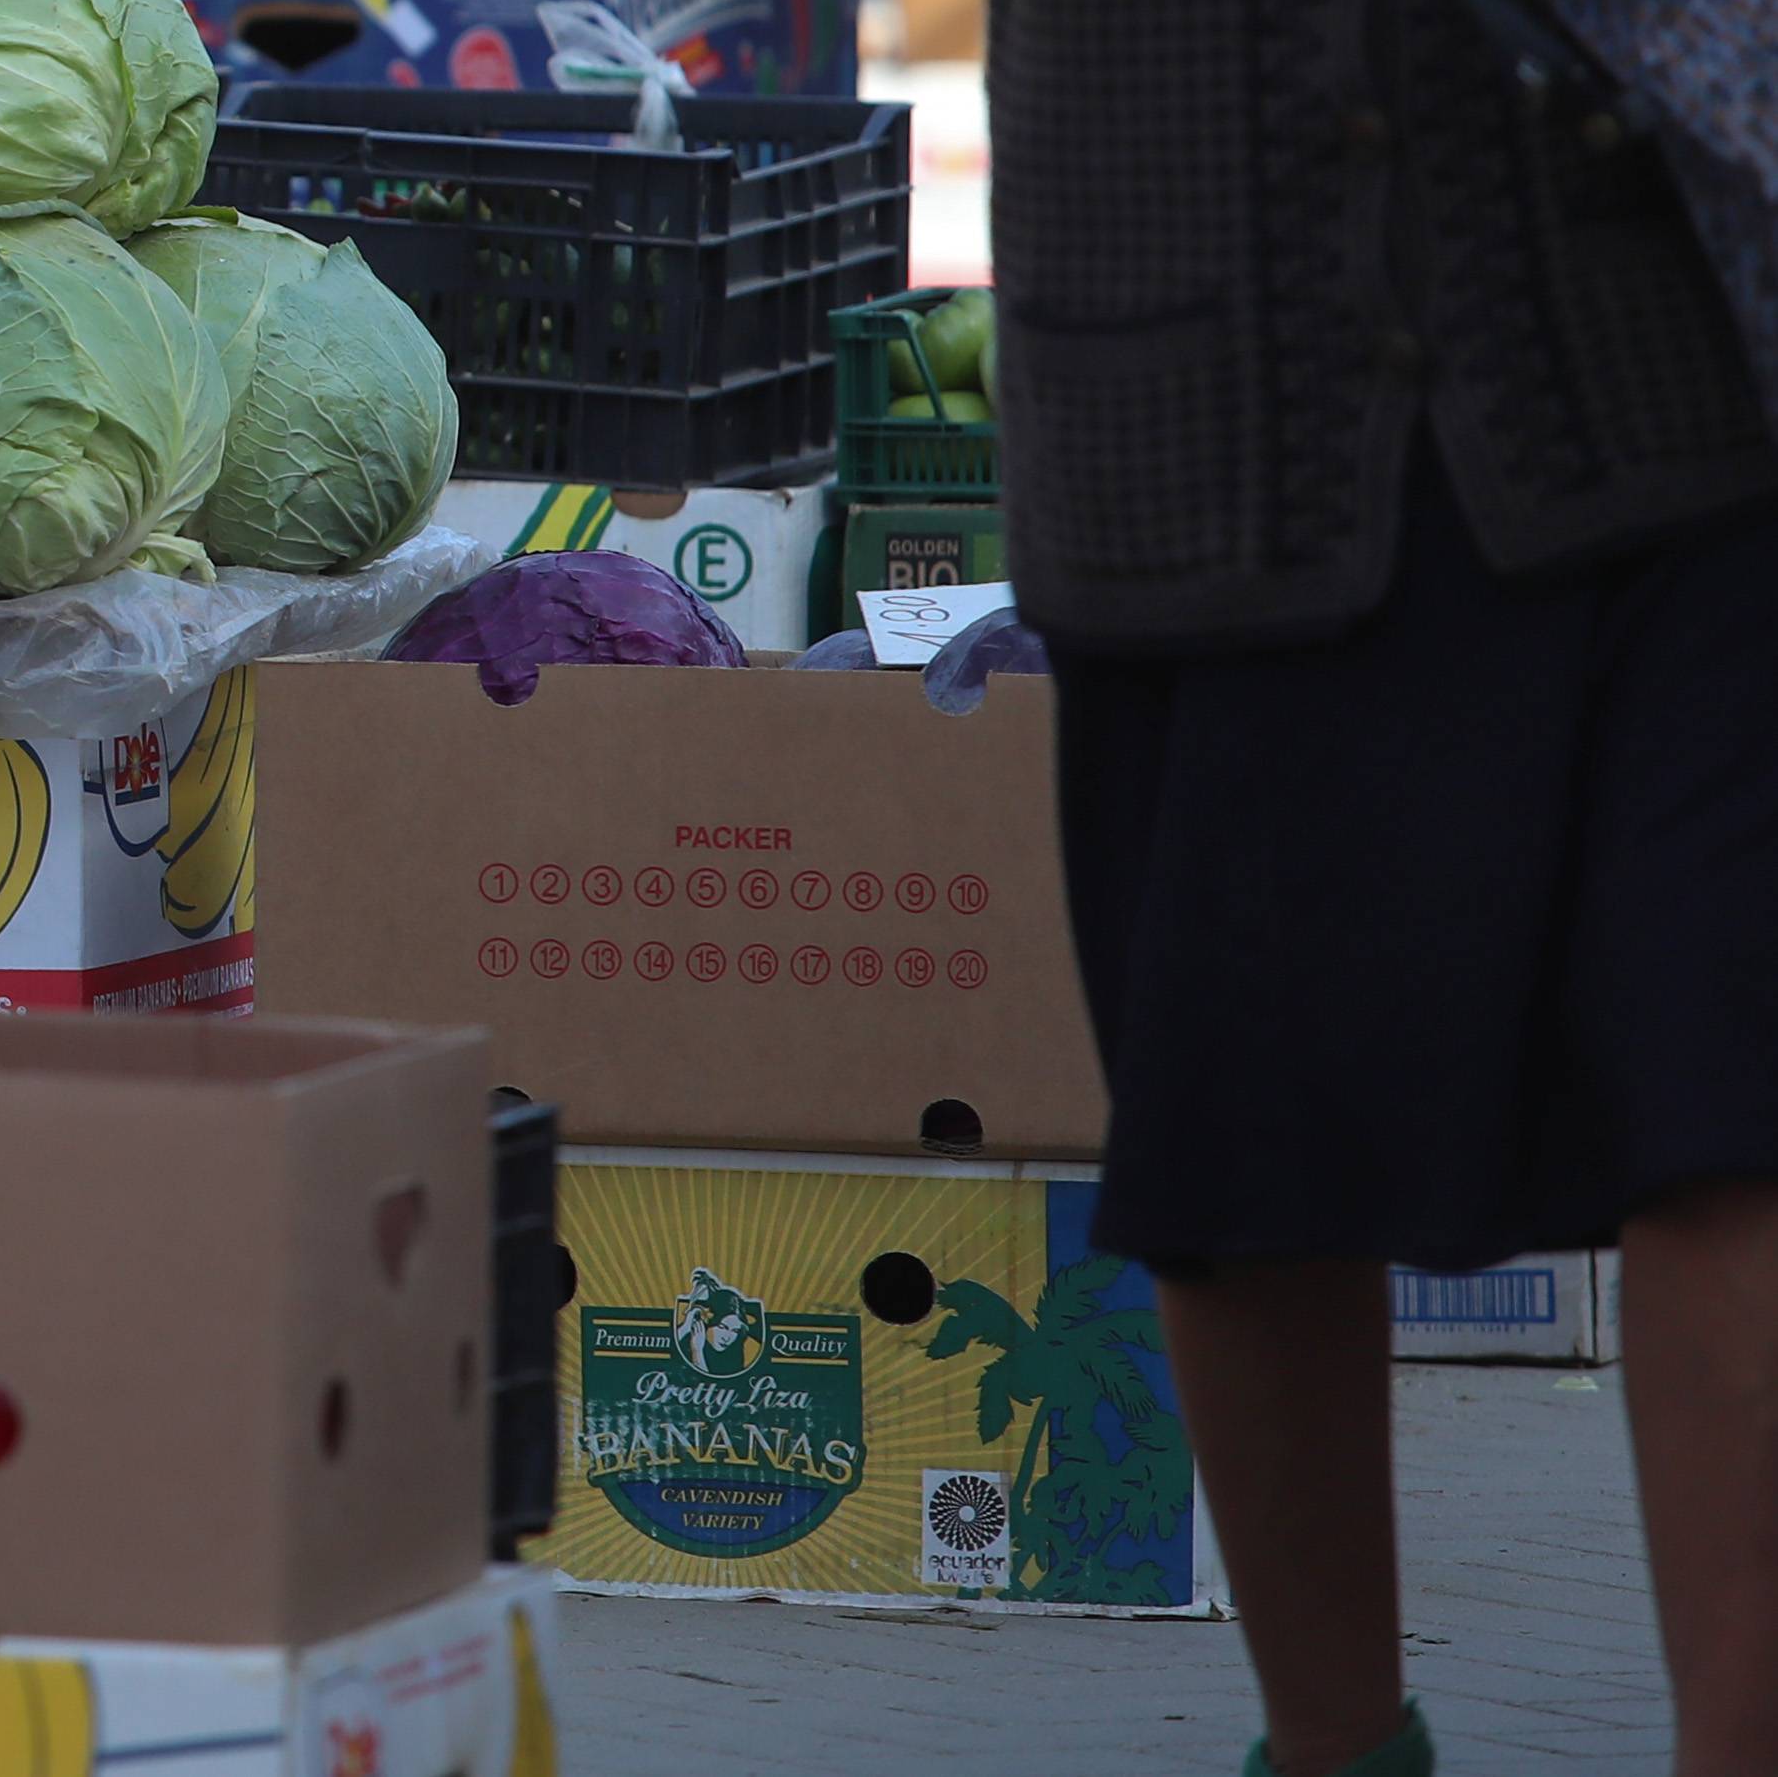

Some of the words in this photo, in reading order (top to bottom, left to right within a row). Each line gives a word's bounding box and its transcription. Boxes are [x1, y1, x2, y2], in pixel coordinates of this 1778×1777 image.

[888, 538, 960, 556] GOLDEN
[888, 560, 960, 589] BIO
[114, 722, 161, 792] Dole
[675, 825, 793, 852] PACKER
[595, 1328, 671, 1348] Premium
[771, 1334, 847, 1359] Quality
[632, 1371, 737, 1418] Pretty
[735, 1375, 811, 1414] Liza
[584, 1421, 856, 1486] BANANAS
[661, 1488, 783, 1506] CAVENDISH
[681, 1513, 764, 1530] VARIETY
[928, 1553, 1005, 1570] ecuador
